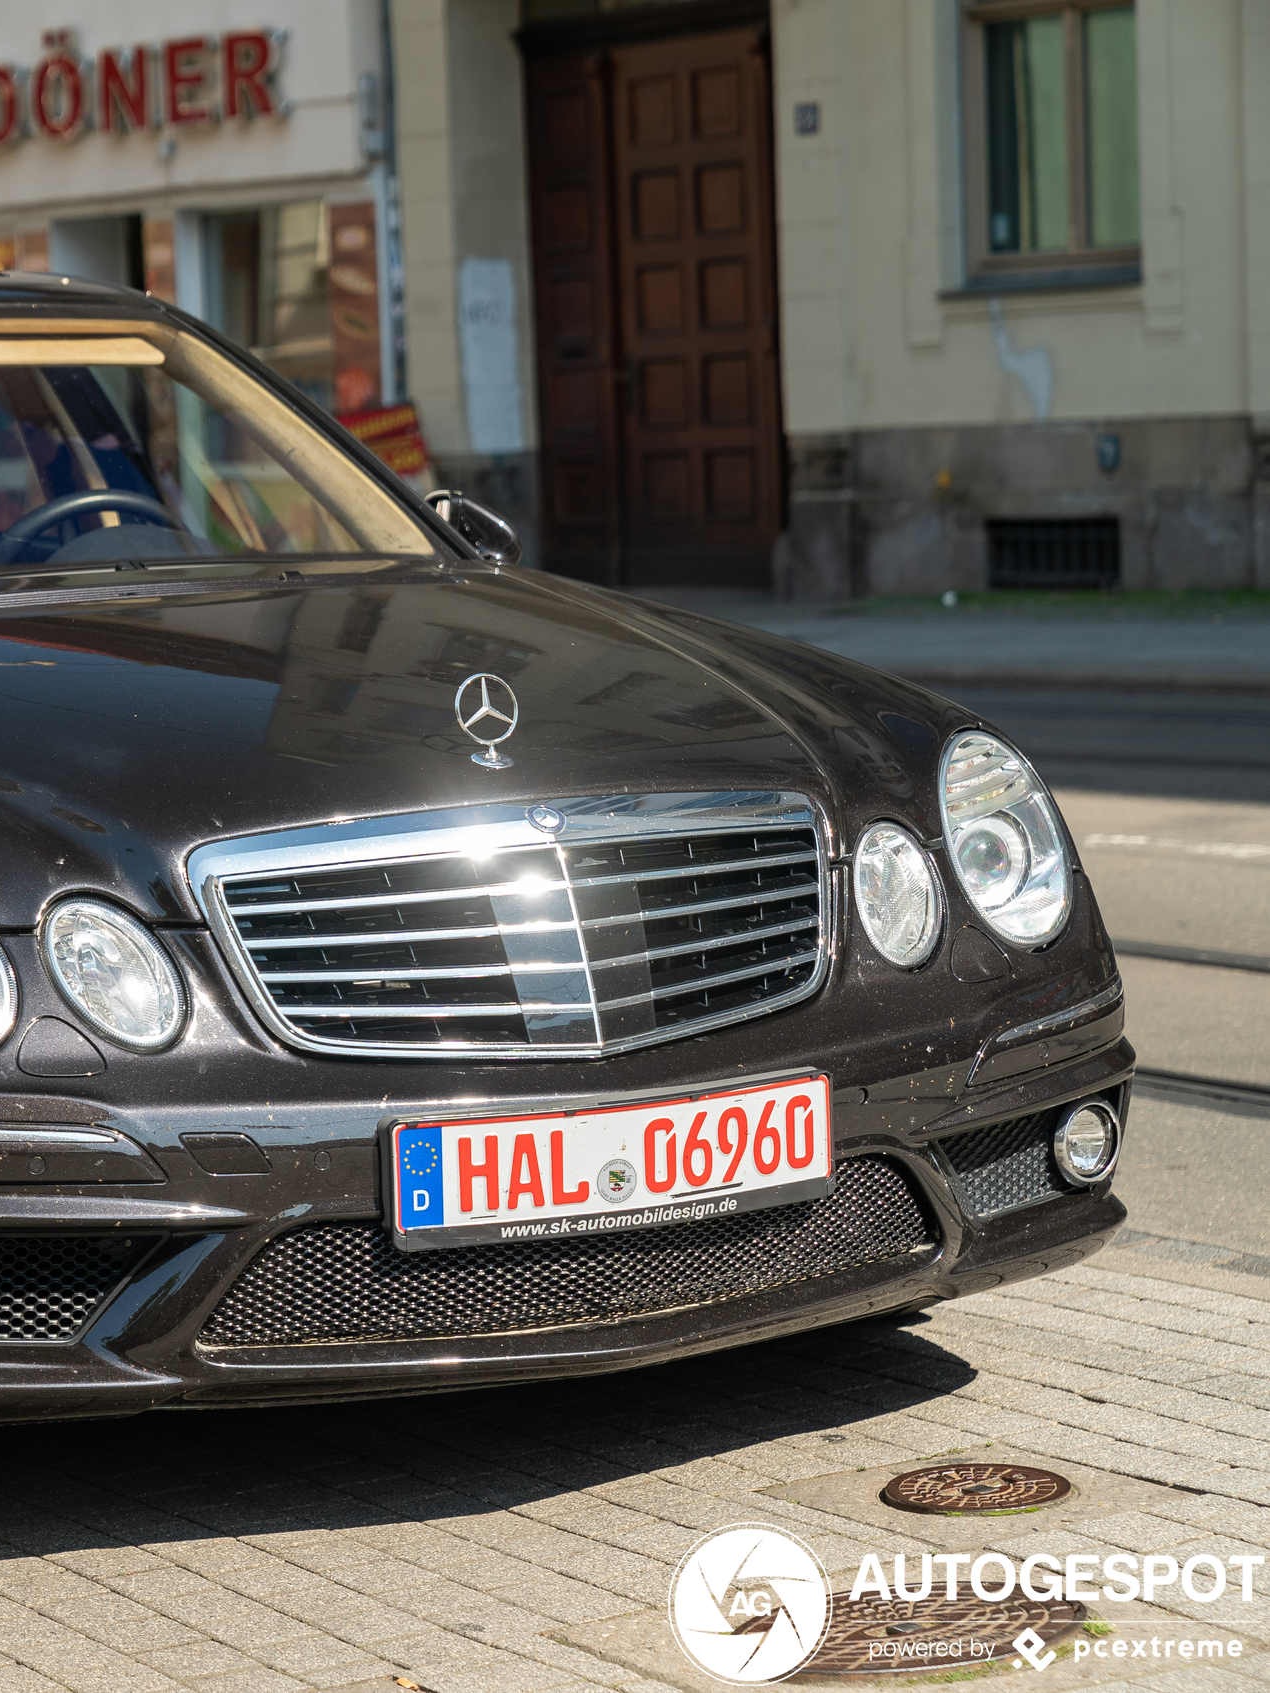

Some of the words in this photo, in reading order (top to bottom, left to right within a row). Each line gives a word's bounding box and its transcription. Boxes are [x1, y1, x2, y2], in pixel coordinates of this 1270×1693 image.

[457, 1129, 590, 1213] HAL
[643, 1094, 814, 1194] 06960
[413, 1189, 430, 1212] D
[500, 1197, 738, 1239] www.sk-automobildesign.de
